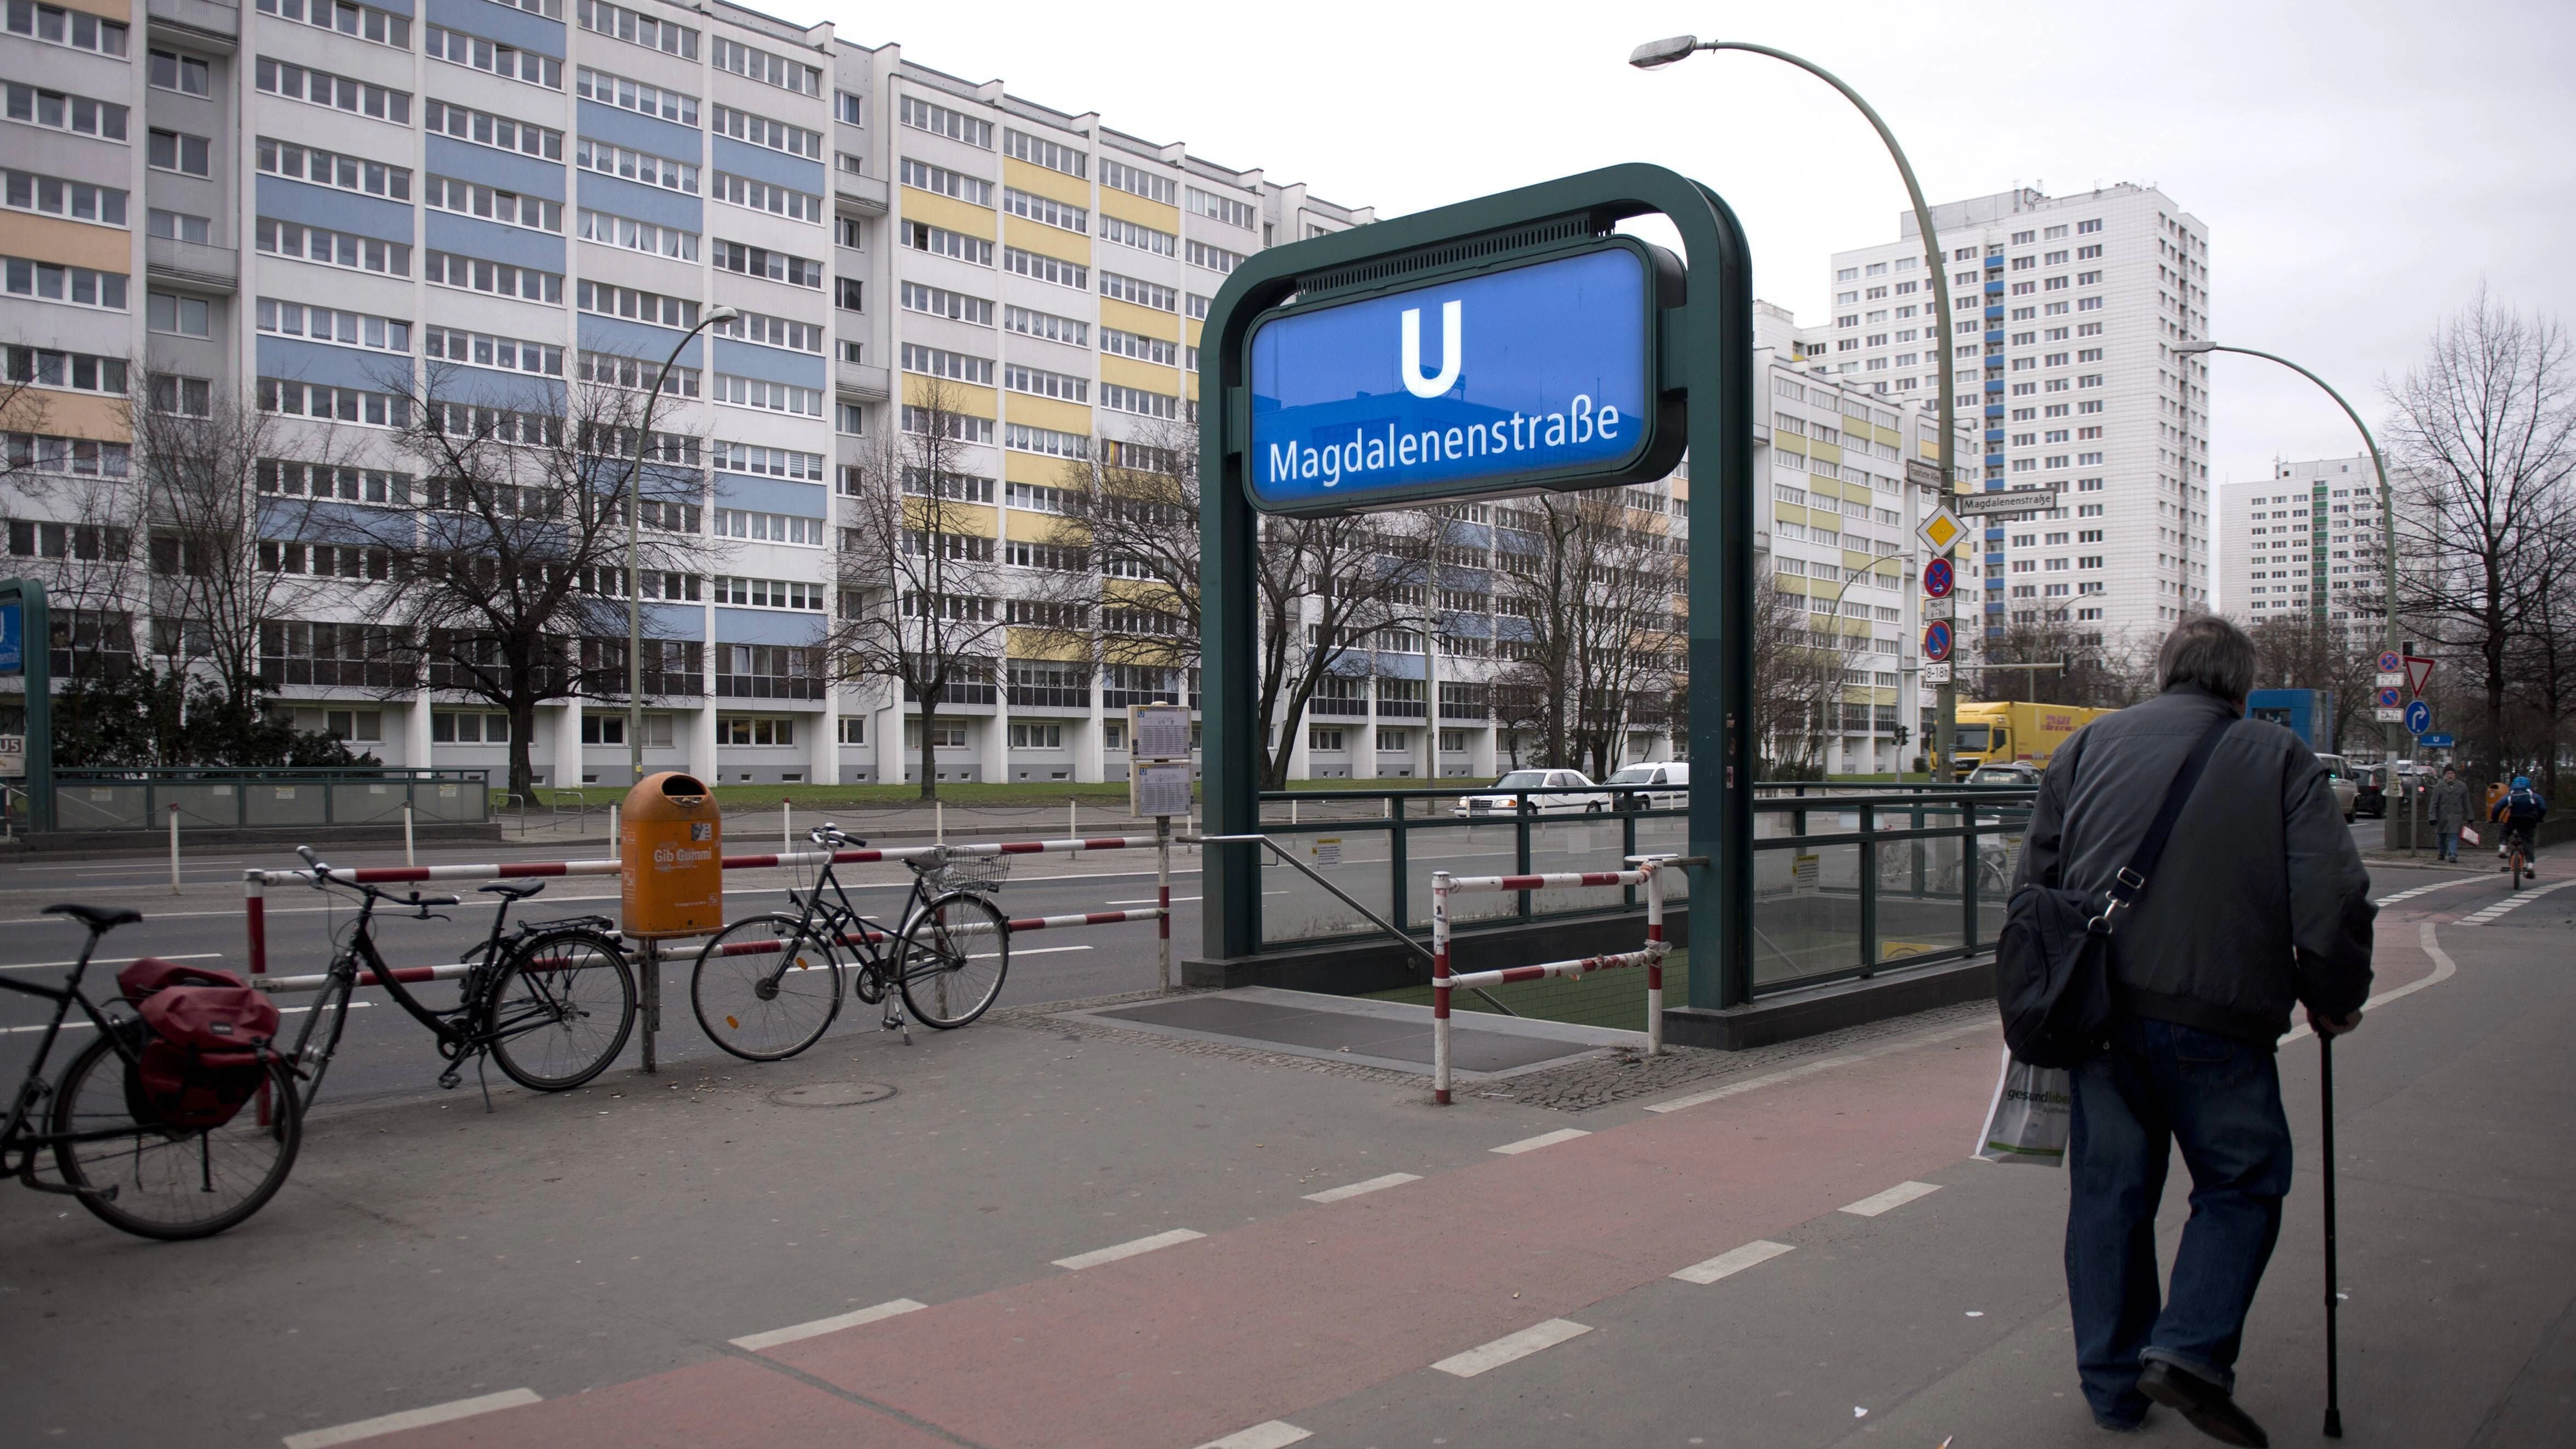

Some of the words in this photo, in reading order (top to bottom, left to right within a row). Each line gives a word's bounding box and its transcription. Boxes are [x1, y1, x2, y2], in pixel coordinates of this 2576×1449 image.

[1401, 300, 1461, 398] U
[1269, 394, 1619, 487] Magdalenenstraße
[1964, 494, 2051, 509] Magdalenenstraße
[1927, 666, 1948, 678] 8-18h
[654, 849, 674, 863] Gib
[676, 846, 712, 861] Gummi
